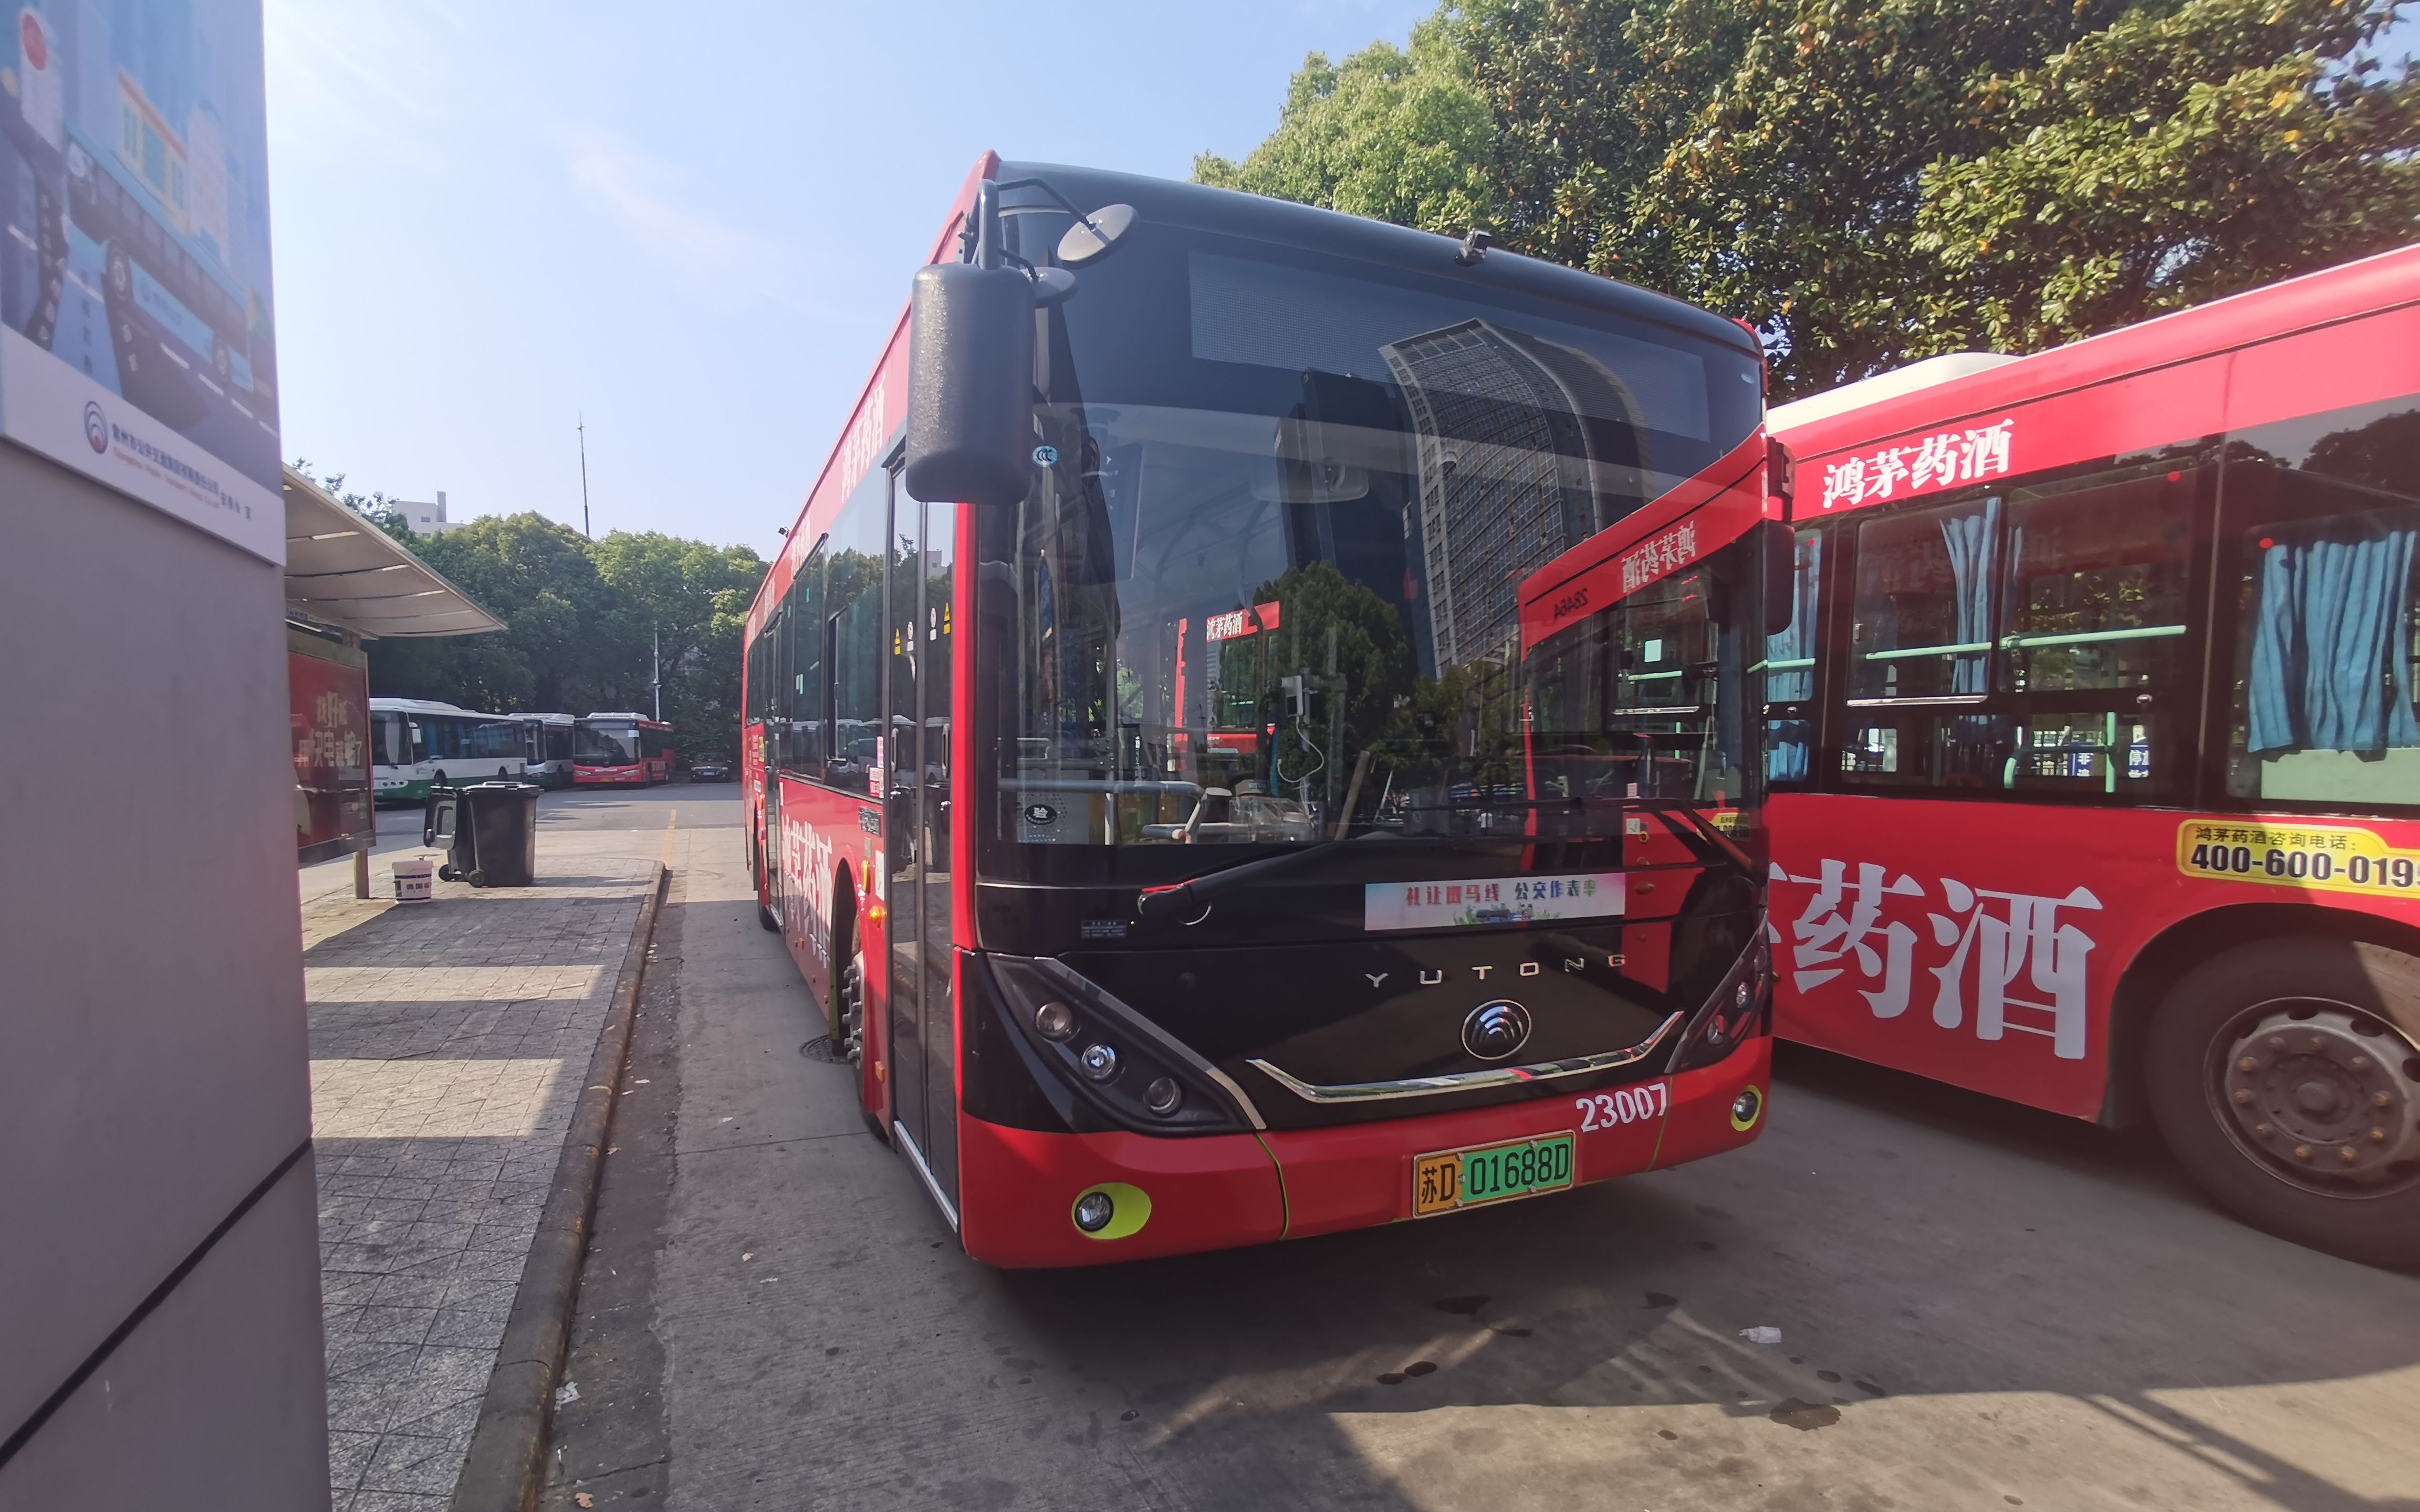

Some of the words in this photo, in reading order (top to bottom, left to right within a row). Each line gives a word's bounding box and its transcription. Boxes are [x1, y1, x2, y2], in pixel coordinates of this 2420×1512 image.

[1822, 418, 2015, 508] 鸿茅药酒
[1033, 807, 1049, 818] 验
[2190, 844, 2420, 888] 400-600-019
[1365, 954, 1626, 988] YUTONG
[1768, 858, 2103, 1059] 药酒
[1576, 1082, 1667, 1133] 23007
[1421, 1163, 1455, 1204] 苏D
[1470, 1142, 1570, 1195] 01688D
